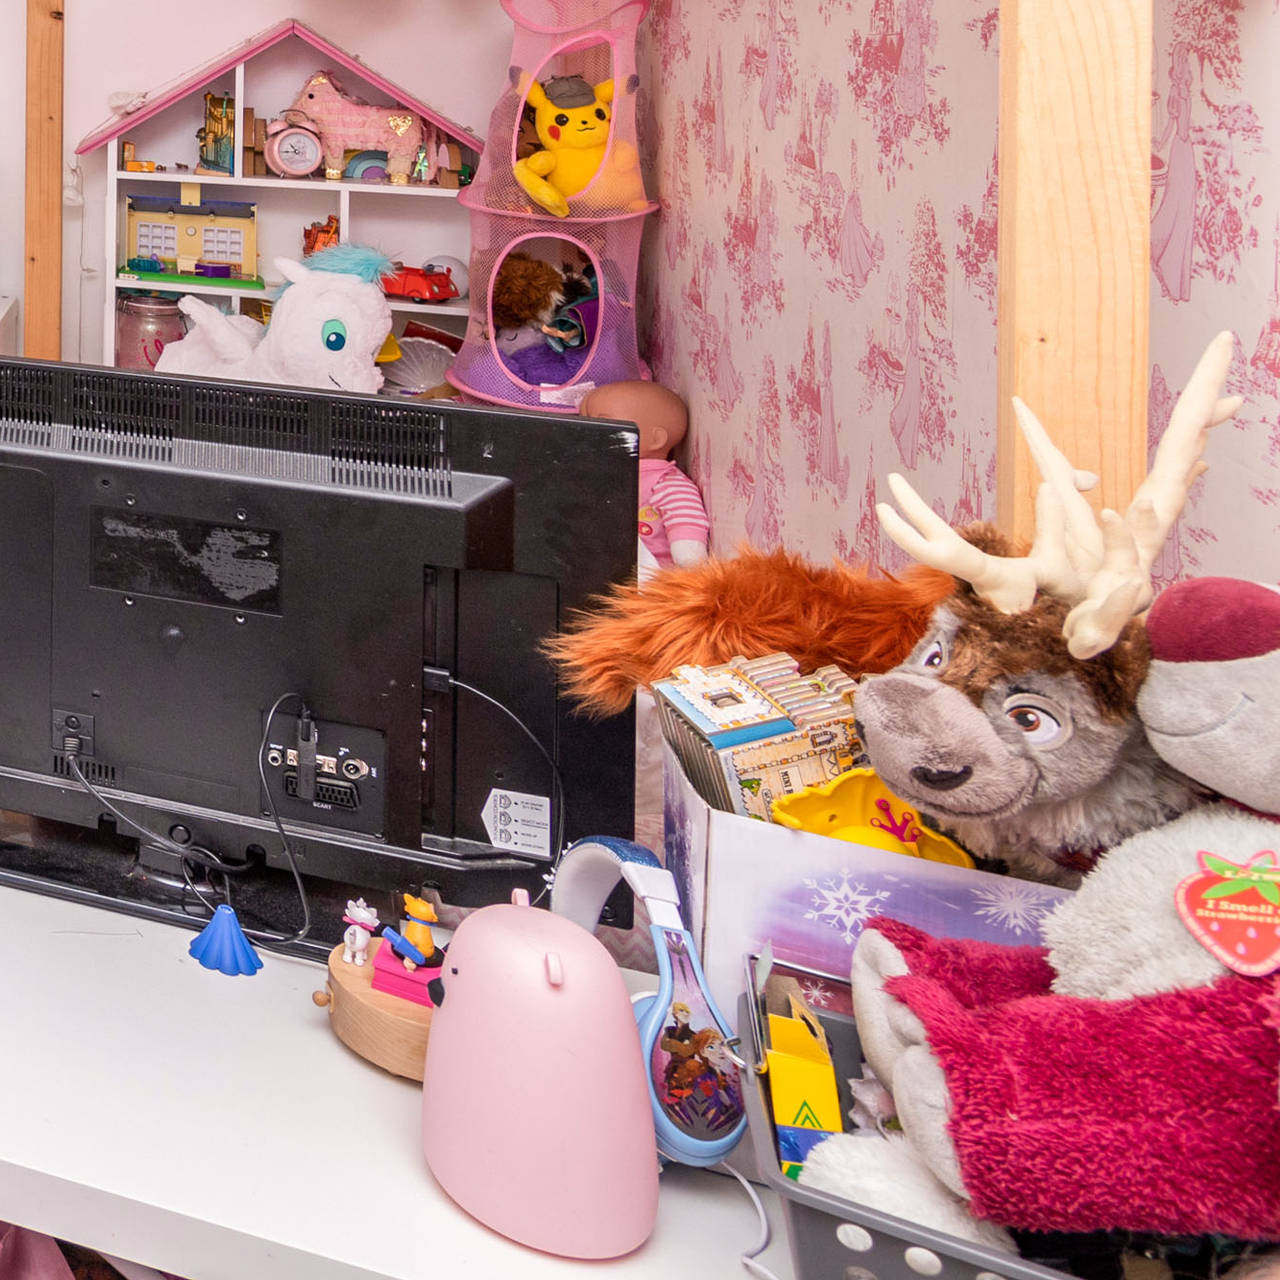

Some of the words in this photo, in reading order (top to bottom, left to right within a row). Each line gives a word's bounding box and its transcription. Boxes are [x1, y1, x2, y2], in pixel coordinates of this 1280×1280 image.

[781, 771, 792, 788] MINI
[1206, 900, 1215, 909] I
[1219, 900, 1274, 914] Smell
